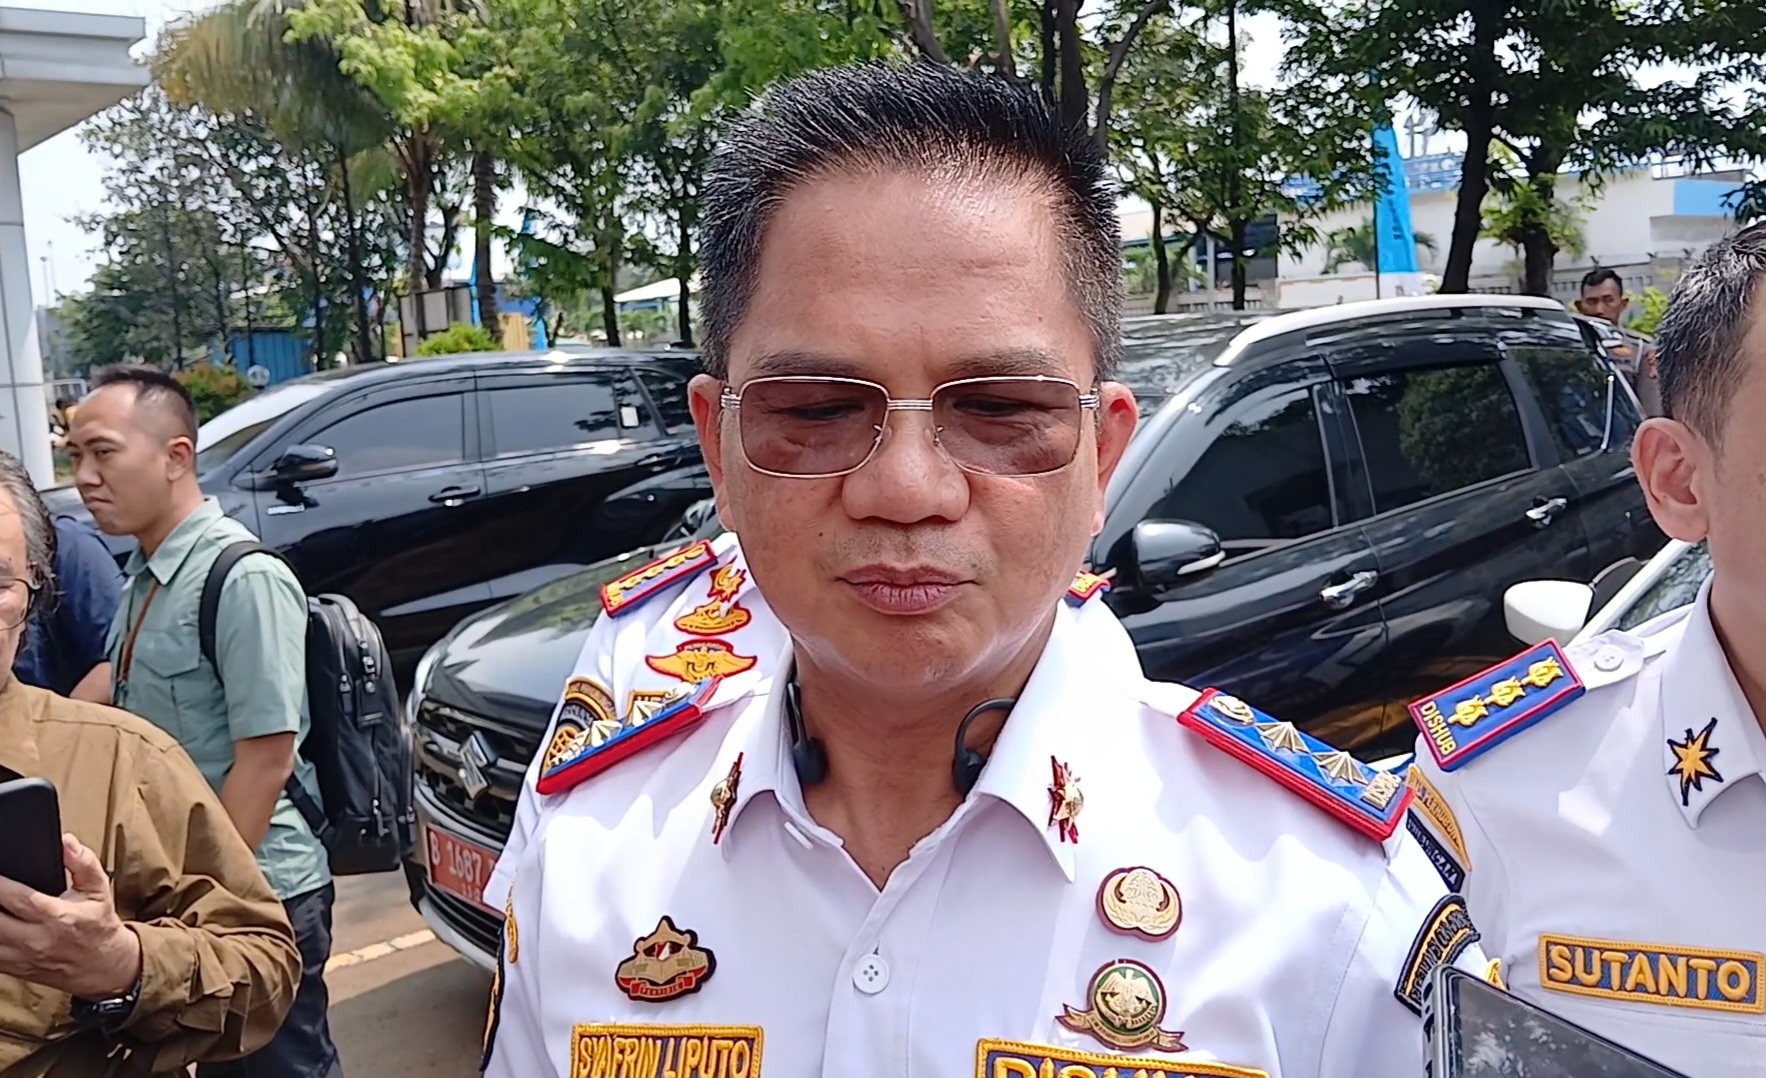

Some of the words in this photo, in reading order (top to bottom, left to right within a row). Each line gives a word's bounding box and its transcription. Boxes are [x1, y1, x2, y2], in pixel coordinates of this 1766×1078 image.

[1420, 701, 1457, 755] DISHUB
[429, 830, 441, 866] B
[446, 840, 482, 886] 1687
[1549, 945, 1750, 1001] SUTANTO
[579, 1035, 662, 1078] SYAFRIN
